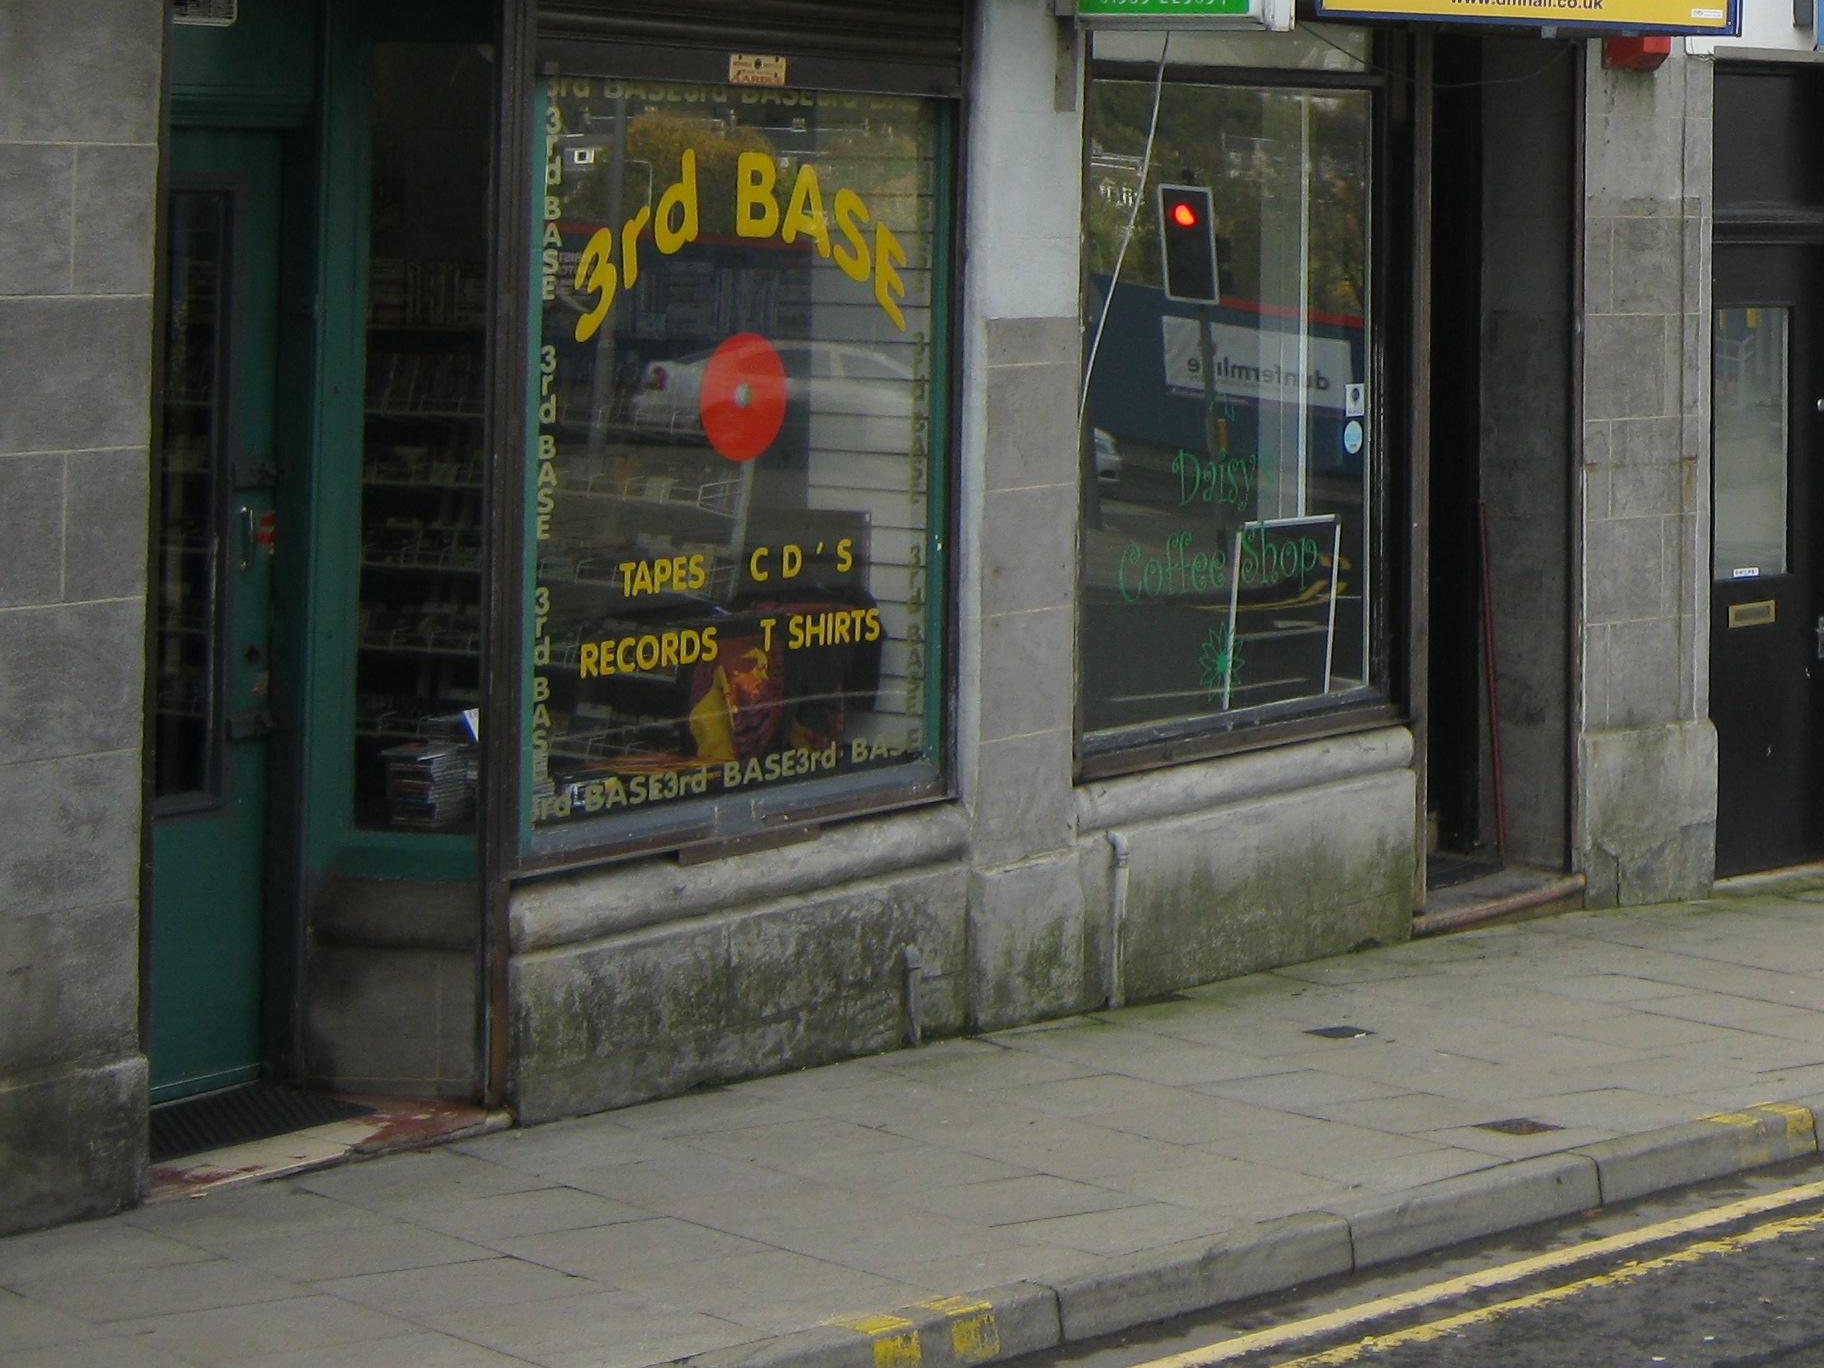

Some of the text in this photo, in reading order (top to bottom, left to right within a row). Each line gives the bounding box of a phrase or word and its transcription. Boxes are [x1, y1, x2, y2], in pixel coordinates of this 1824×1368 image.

[574, 147, 699, 343] 3rd
[735, 151, 907, 332] BASE
[619, 553, 706, 598] TAPES
[1119, 519, 1319, 603] Coffee Shop
[579, 606, 882, 680] RECORDS T SHIRTS
